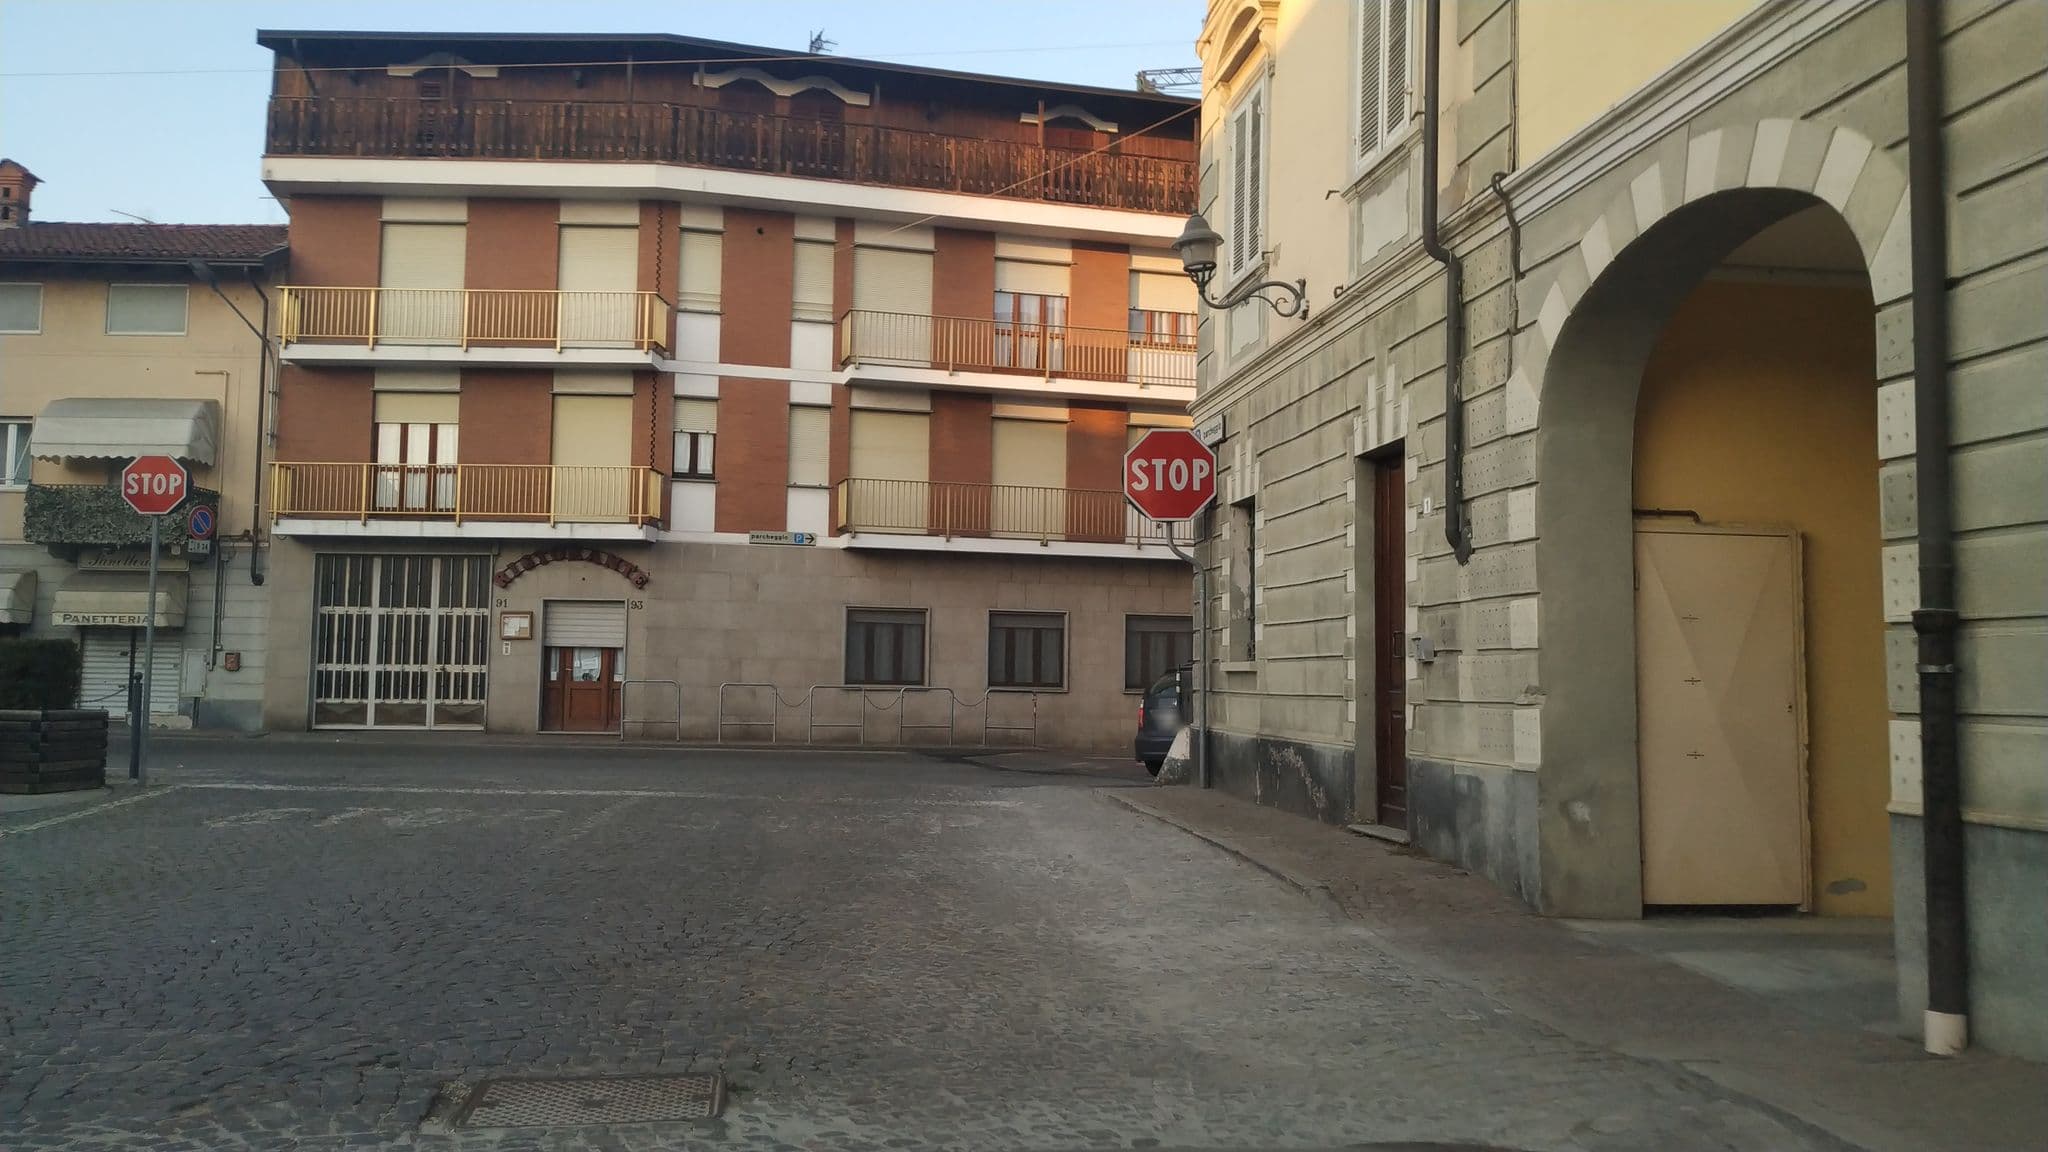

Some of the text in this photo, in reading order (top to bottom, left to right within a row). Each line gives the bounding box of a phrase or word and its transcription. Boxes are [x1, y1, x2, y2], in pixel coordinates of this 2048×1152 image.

[1131, 458, 1210, 491] STOP
[127, 473, 182, 495] STOP
[495, 598, 507, 608] 91
[631, 600, 644, 610] 93
